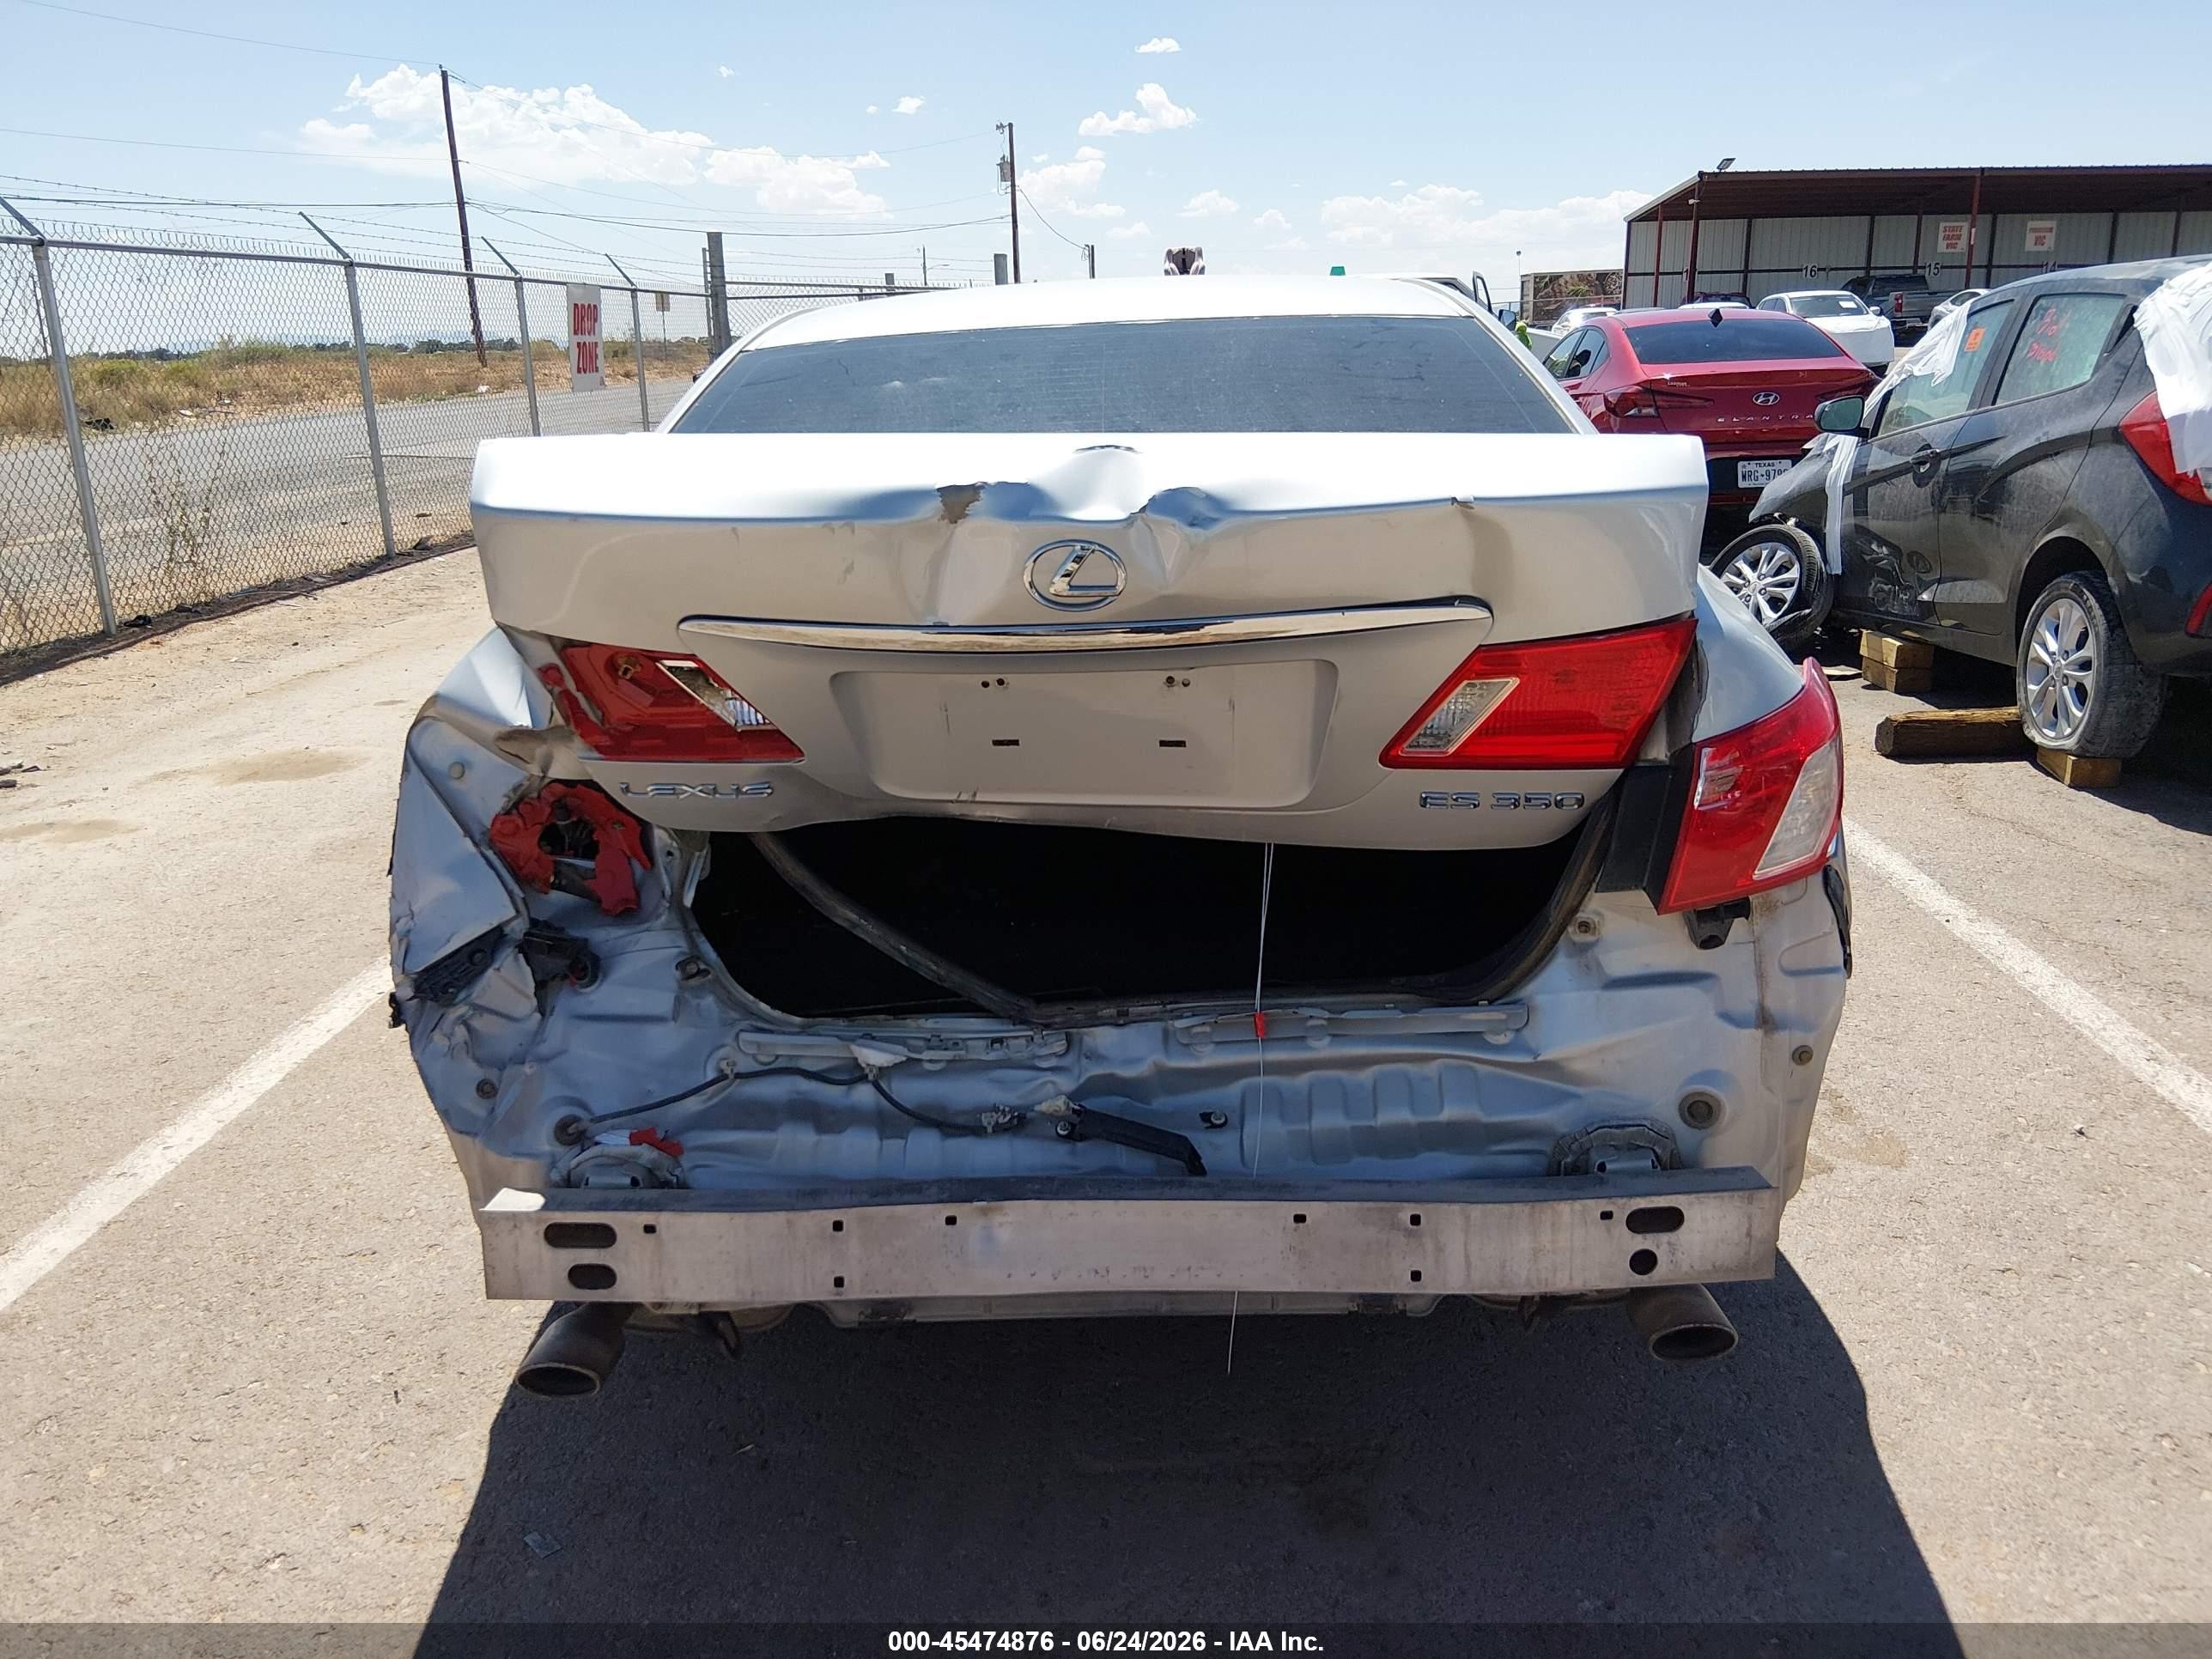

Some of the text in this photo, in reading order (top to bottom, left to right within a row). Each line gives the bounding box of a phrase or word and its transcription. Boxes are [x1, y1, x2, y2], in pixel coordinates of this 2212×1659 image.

[1803, 264, 1817, 278] 16
[1926, 262, 1941, 276] 15
[573, 303, 599, 336] DROP
[576, 342, 599, 374] ZONE
[1717, 413, 1814, 422] ELANTRA
[1741, 470, 1759, 483] WRG
[618, 782, 773, 799] LEXUS
[1419, 791, 1585, 810] ES 350
